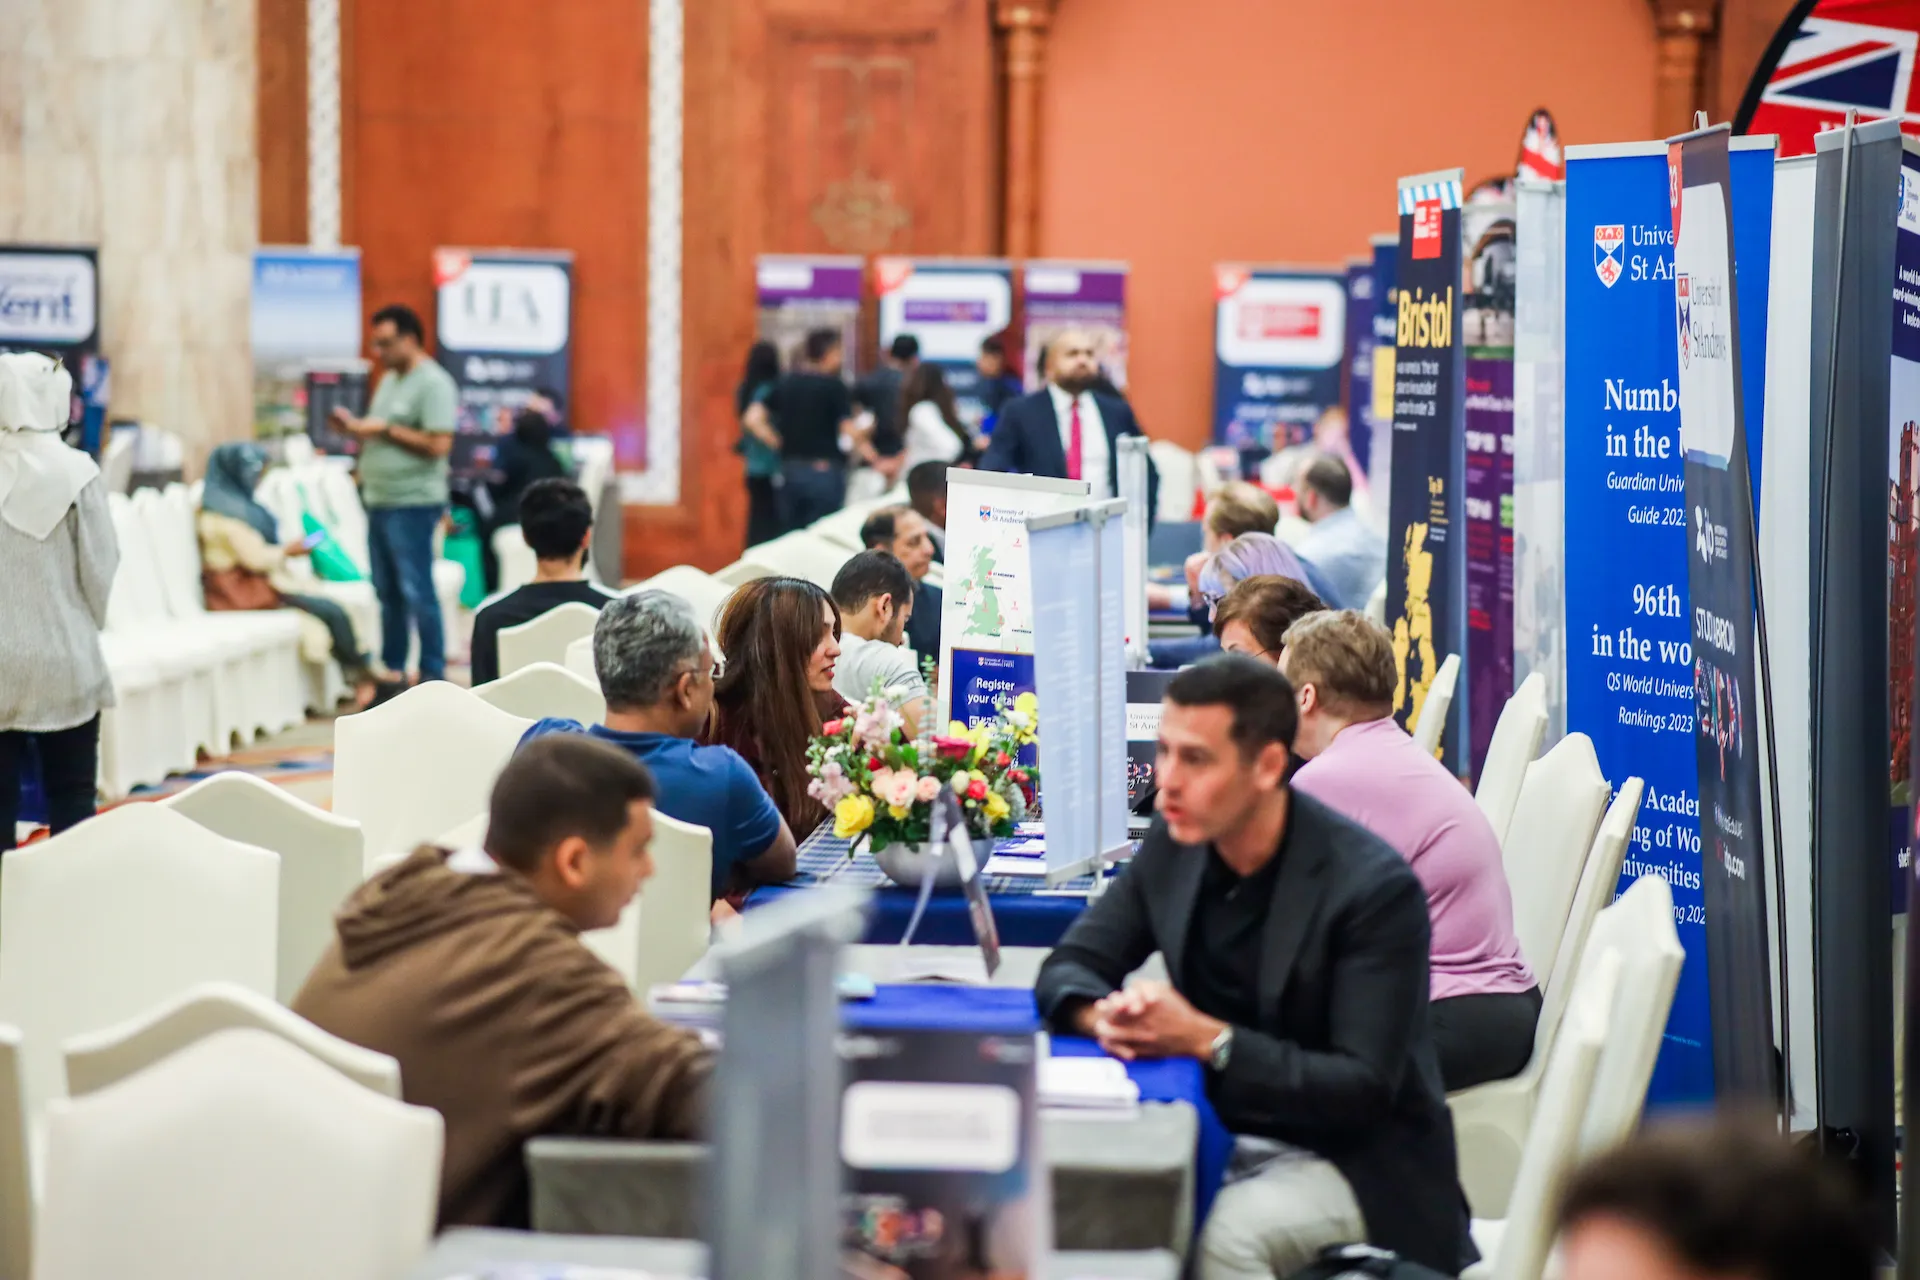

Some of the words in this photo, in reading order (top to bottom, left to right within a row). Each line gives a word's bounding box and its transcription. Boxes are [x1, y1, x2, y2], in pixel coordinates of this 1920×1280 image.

[1630, 254, 1648, 281] St
[1396, 285, 1453, 349] Bristol
[1604, 378, 1681, 412] Numb
[1605, 424, 1628, 457] in
[1633, 425, 1671, 459] the
[1607, 471, 1656, 492] Guardian
[1658, 473, 1685, 492] Univ
[1628, 505, 1660, 525] Guide
[1633, 584, 1682, 618] 96th
[1592, 623, 1613, 657] in
[1618, 627, 1651, 662] the
[1658, 640, 1692, 666] wo
[976, 677, 1015, 692] Register
[1607, 672, 1621, 692] QS
[1623, 674, 1653, 695] World
[1655, 678, 1694, 700] Univers
[967, 693, 989, 705] your
[1618, 706, 1666, 733] Rankings
[1668, 713, 1694, 733] 2023
[1630, 825, 1651, 852] ng
[1655, 824, 1673, 849] of
[1676, 826, 1701, 853] Wo
